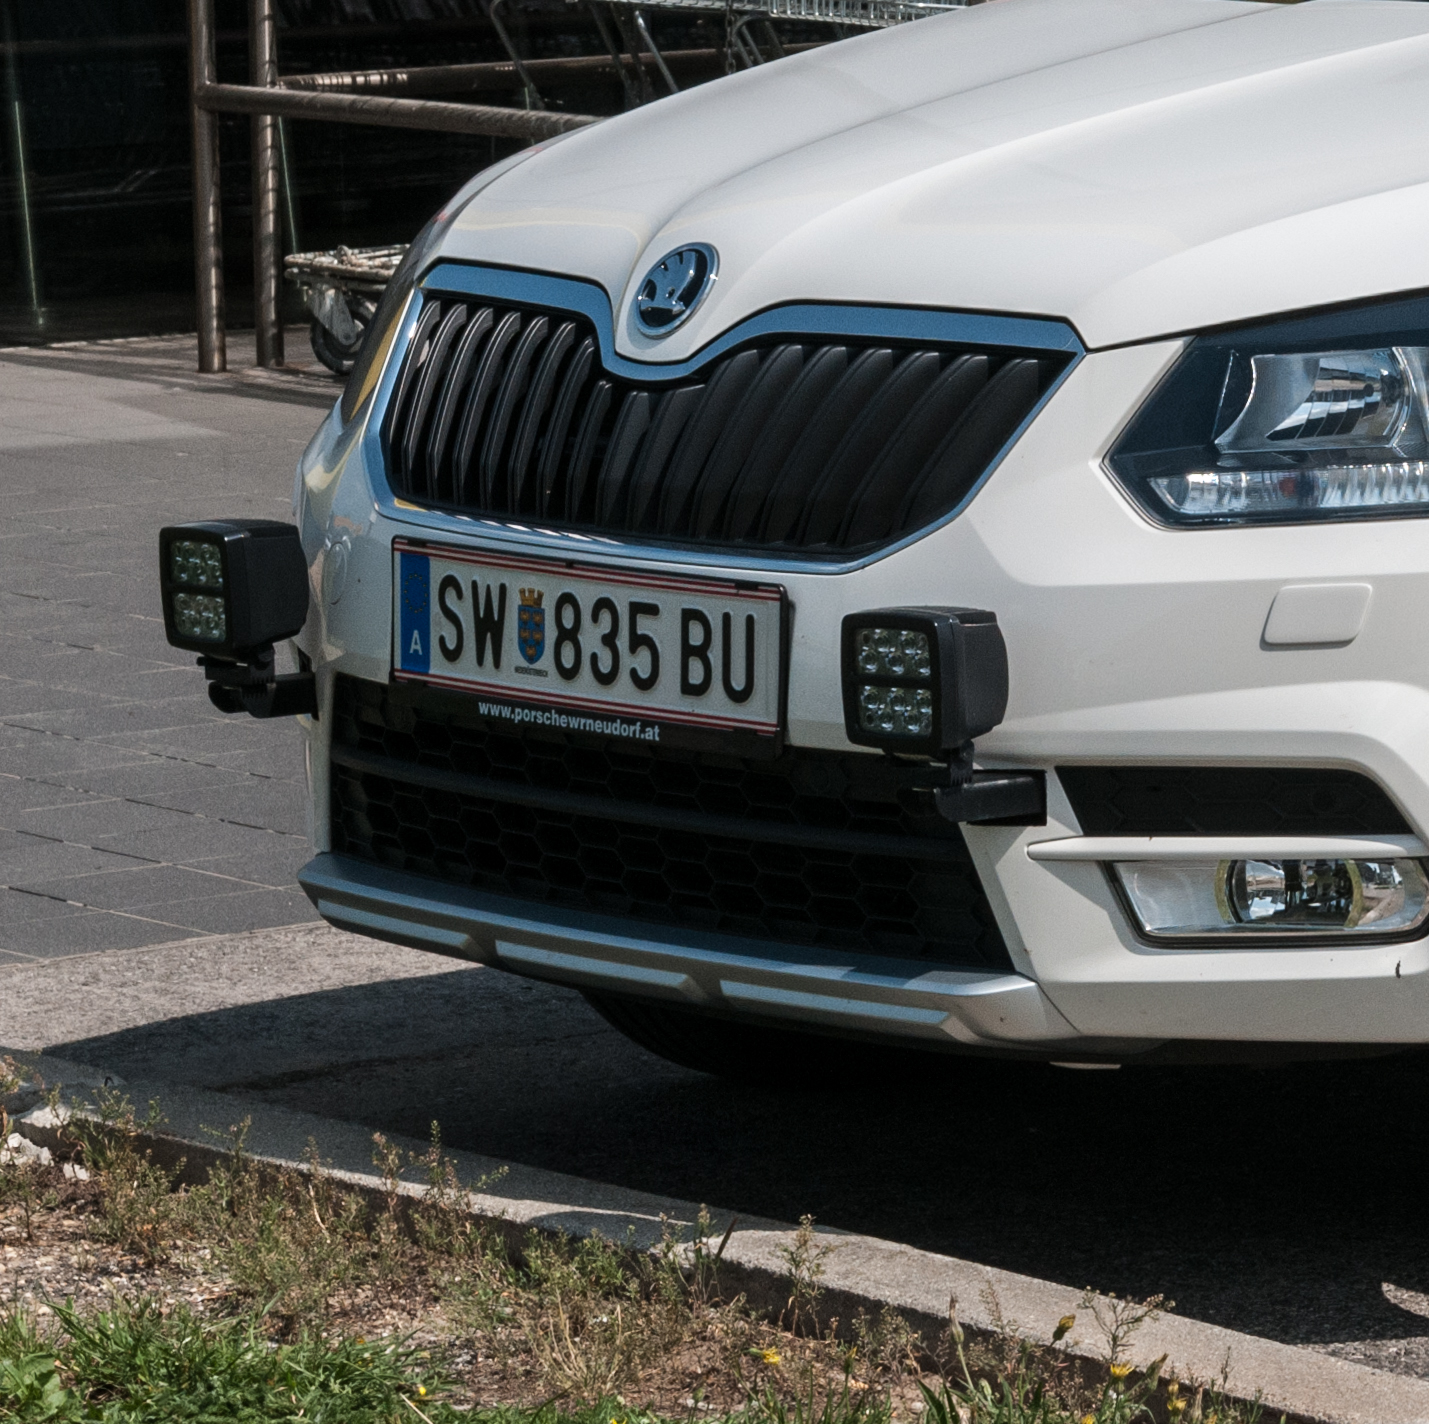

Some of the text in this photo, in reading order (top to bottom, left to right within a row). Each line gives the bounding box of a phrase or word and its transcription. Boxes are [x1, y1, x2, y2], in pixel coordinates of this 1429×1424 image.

[409, 630, 423, 655] A
[438, 574, 756, 704] SW 835 BU
[478, 700, 660, 742] www.porschewrneudorf.at
